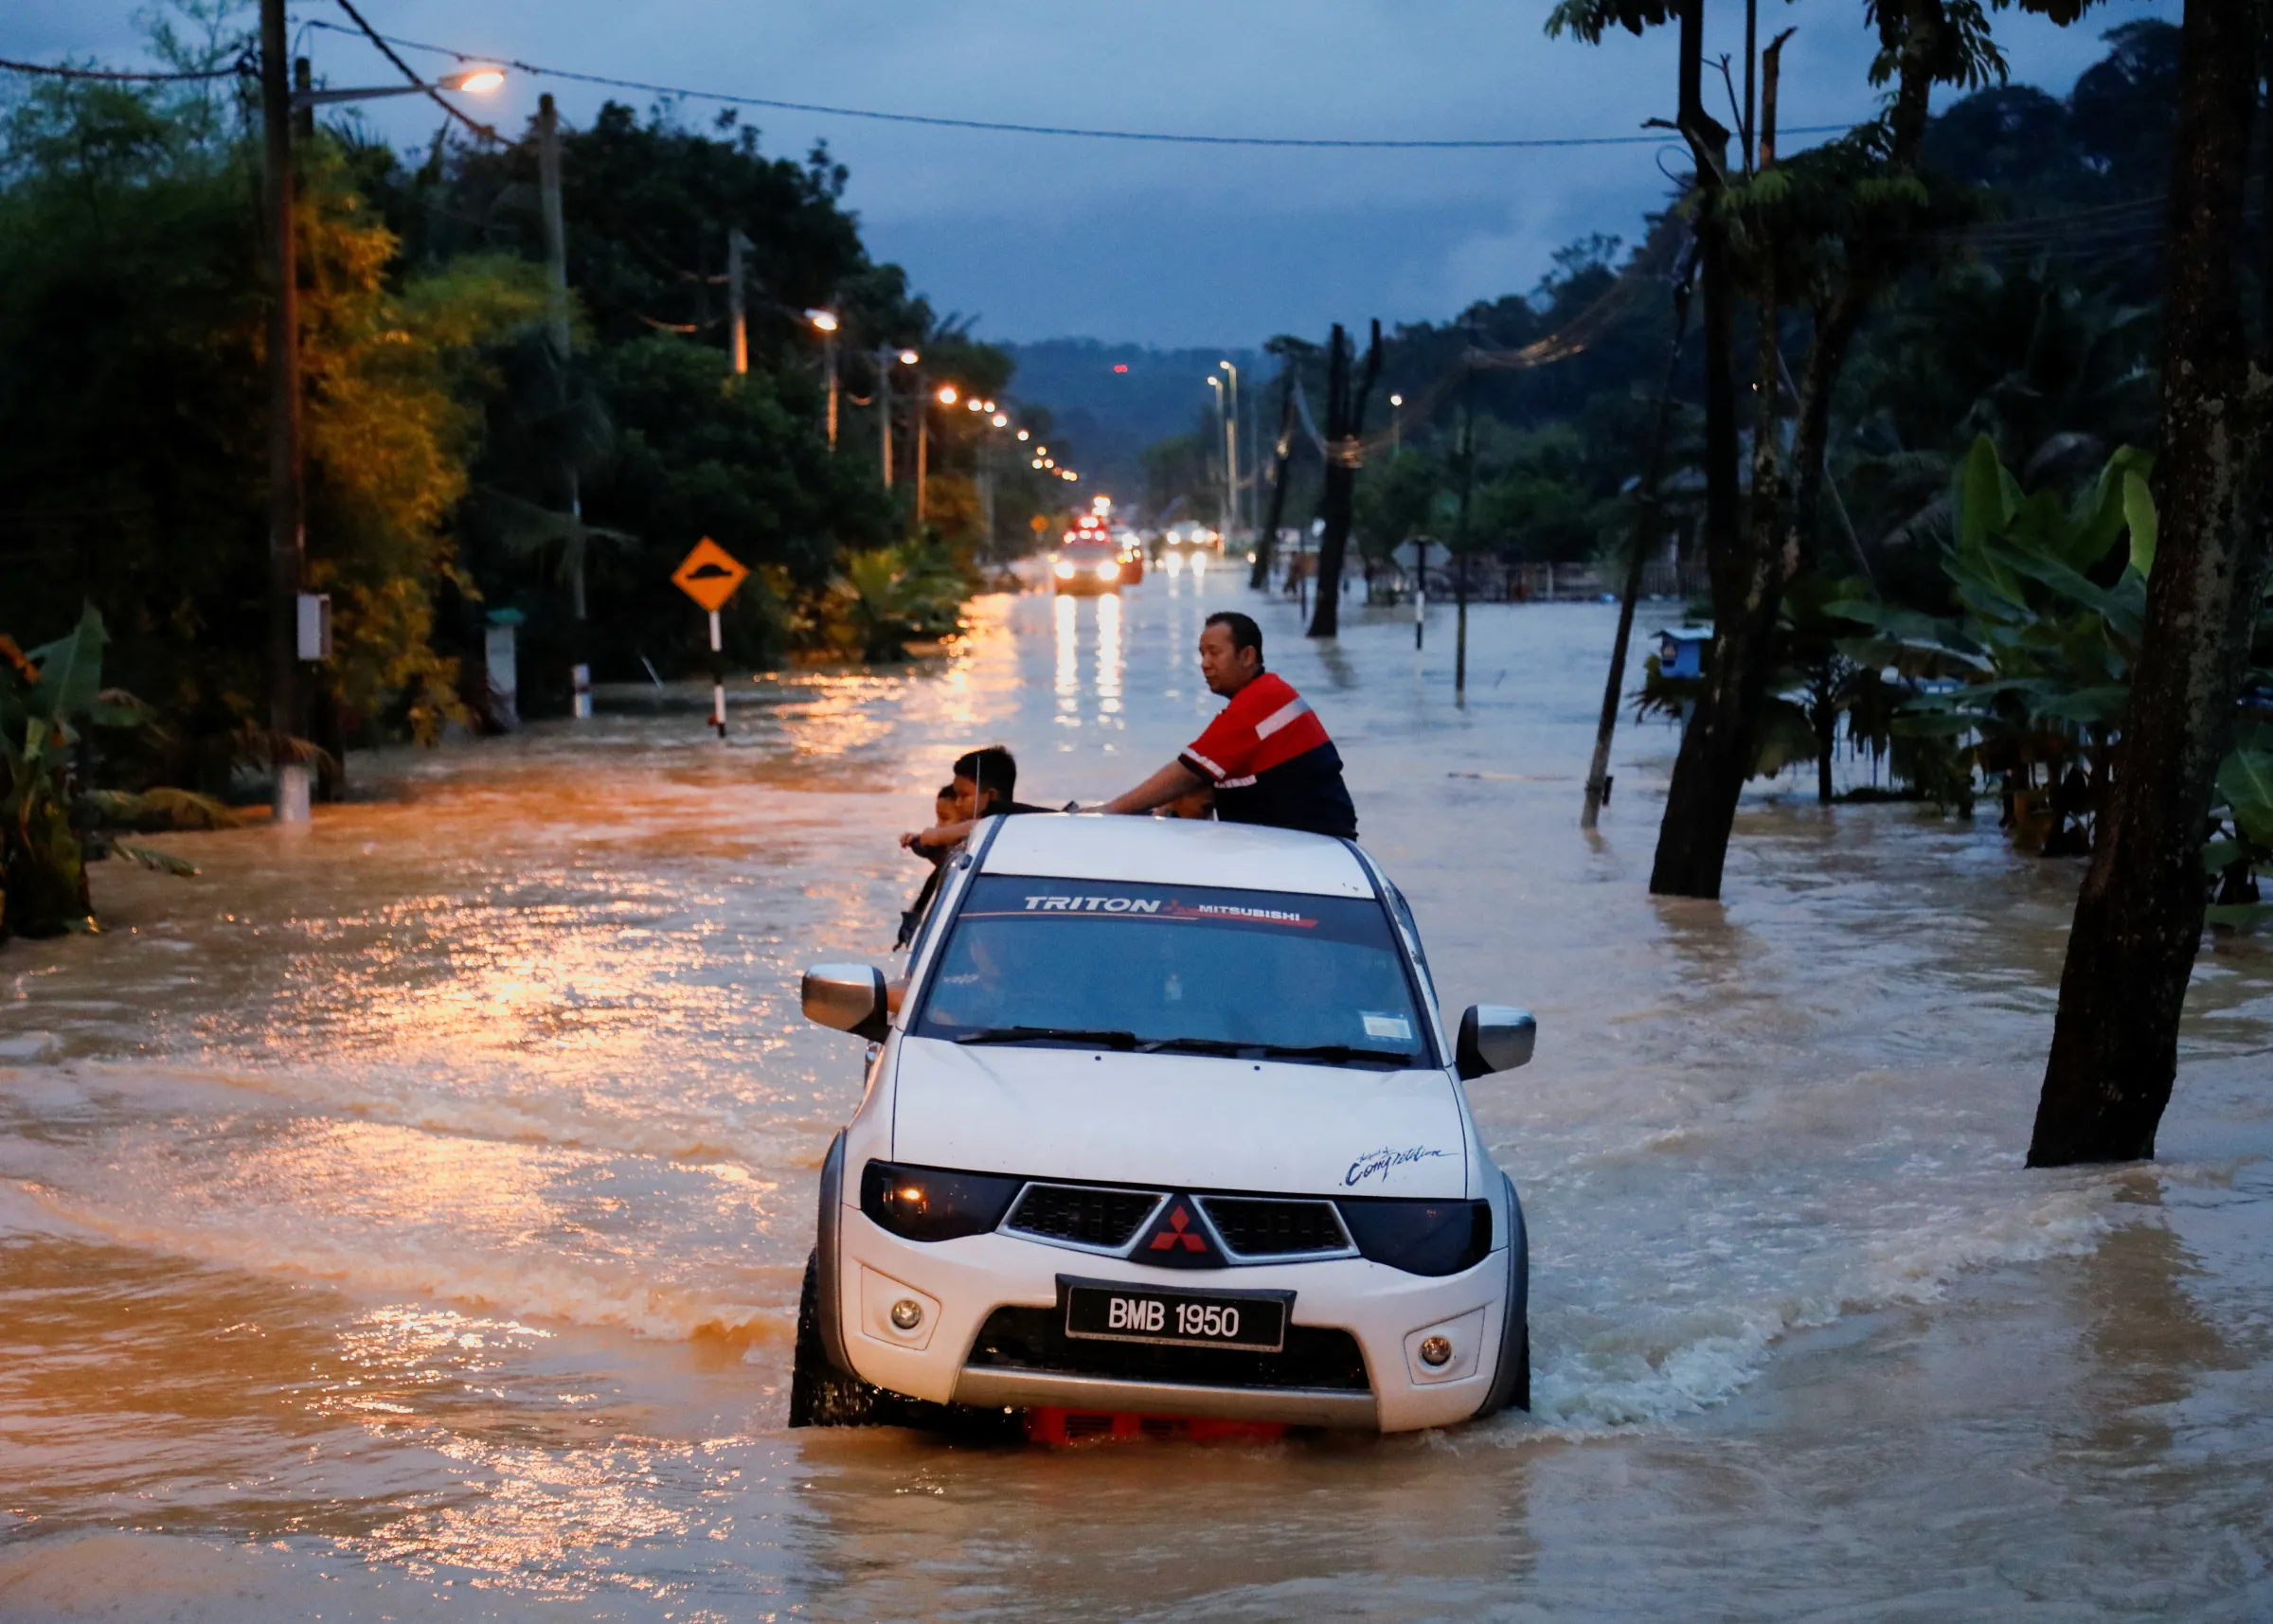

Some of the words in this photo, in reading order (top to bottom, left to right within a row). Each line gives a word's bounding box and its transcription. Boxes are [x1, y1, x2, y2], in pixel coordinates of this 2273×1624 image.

[1025, 896, 1161, 913] TRITON
[1198, 904, 1300, 921] MITSUBISHI
[1109, 1297, 1165, 1331] BMB
[1175, 1303, 1239, 1337] 1950
